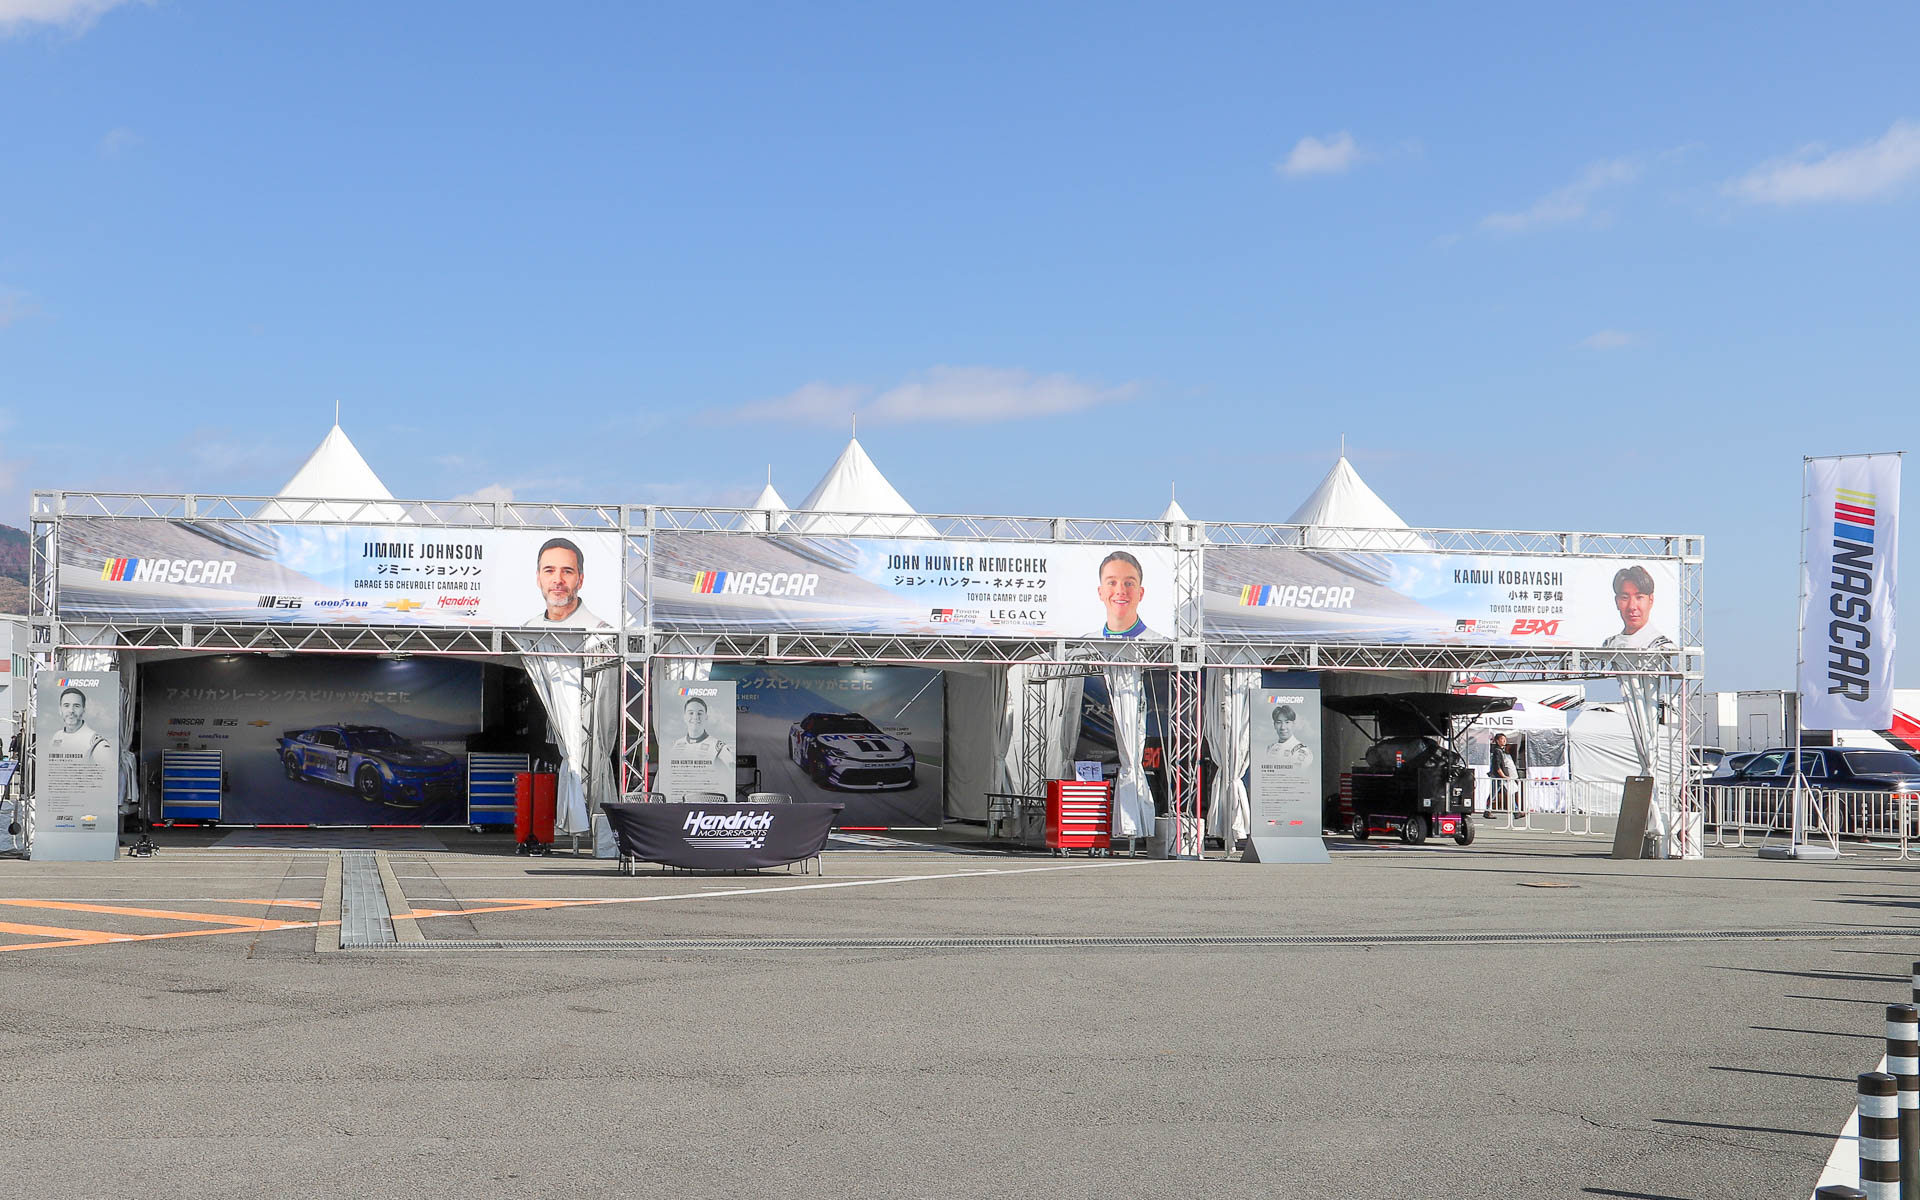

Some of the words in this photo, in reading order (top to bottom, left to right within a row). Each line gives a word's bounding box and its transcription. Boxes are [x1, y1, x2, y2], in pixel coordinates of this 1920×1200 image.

[362, 542, 415, 558] JIMMIE
[419, 543, 483, 560] JOHNSON
[887, 554, 920, 570] JOHN
[925, 556, 974, 572] HUNTER
[979, 557, 1047, 573] NEMECHEK
[134, 558, 237, 584] NASCAR
[377, 564, 482, 576] ジミー・ジョンソン
[894, 575, 1046, 589] ジョン・ハンター・ネメチェク
[1454, 569, 1494, 584] KAMUI
[1498, 570, 1563, 586] KOBAYASHI
[354, 580, 382, 589] GARAGE
[384, 580, 394, 589] 56
[396, 580, 435, 590] CHEVROLET
[437, 581, 468, 590] CAMARO
[722, 572, 819, 596] NASCAR
[437, 595, 481, 608] Hendrick
[967, 592, 991, 601] TOYOTA
[993, 593, 1016, 602] CAMRY
[1018, 594, 1032, 603] CUP
[1034, 594, 1048, 603] CAR
[1266, 585, 1355, 608] NASCAR
[1508, 590, 1529, 601] 小林
[1533, 590, 1564, 602] 可夢偉
[313, 599, 369, 609] GOODYEAR
[1490, 604, 1512, 613] TOYOTA
[1513, 605, 1535, 614] CAMRY
[1537, 606, 1549, 614] CUP
[1551, 606, 1563, 614] CAR
[990, 609, 1047, 620] LEGACY
[1827, 539, 1873, 702] NASCAR
[67, 679, 100, 687] NASCAR
[687, 688, 718, 697] NASCAR
[1277, 696, 1304, 704] NASCAR
[175, 718, 205, 726] NASCAR
[337, 759, 347, 772] 24
[682, 811, 775, 836] Hendrick
[698, 829, 768, 837] MOTORSPORTS
